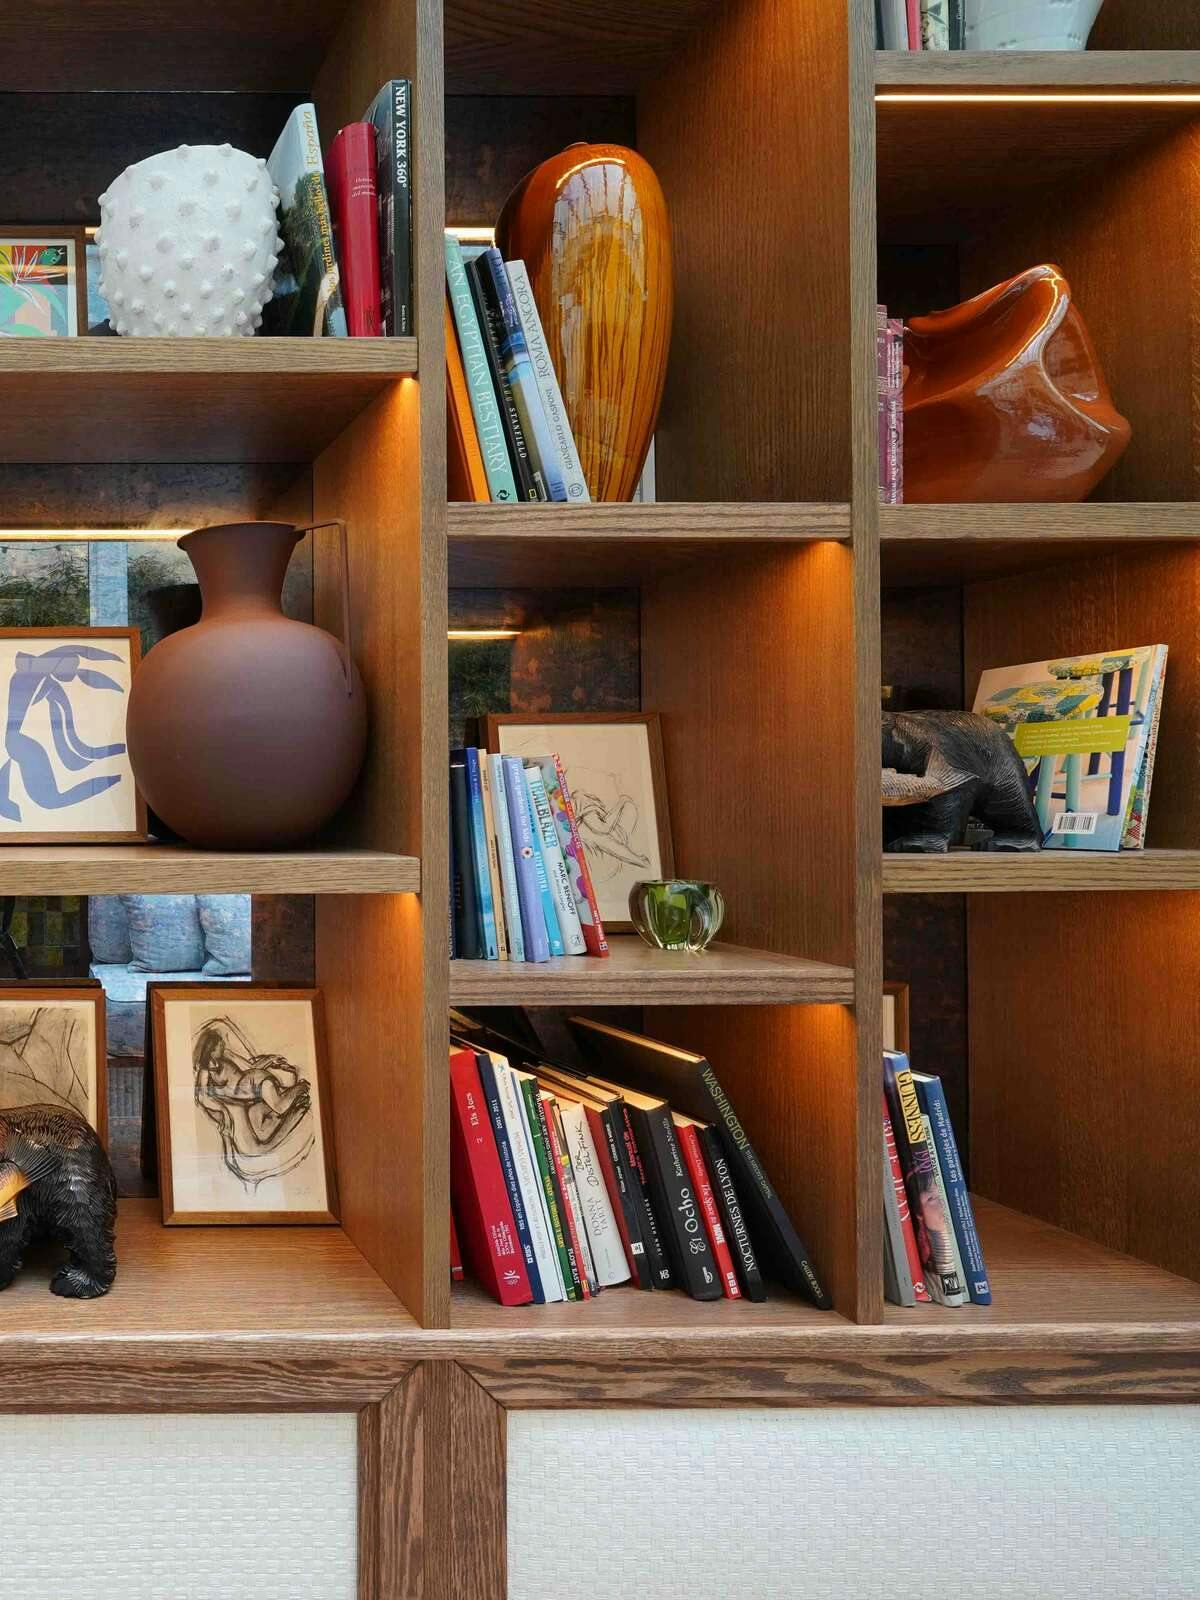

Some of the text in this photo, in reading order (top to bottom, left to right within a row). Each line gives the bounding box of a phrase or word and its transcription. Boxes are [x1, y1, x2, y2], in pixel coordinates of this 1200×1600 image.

[395, 86, 408, 189] NEW YORK 360°
[312, 184, 325, 214] bellos
[511, 274, 551, 379] ROMA ANCORA
[450, 261, 511, 473] AN EGYPTIAN BESTIARY
[509, 407, 526, 458] STANFIELD
[514, 785, 527, 814] gardens
[529, 778, 558, 849] TRAILBLAZER
[557, 772, 570, 803] POLYMER
[569, 817, 583, 849] PROJECTS
[519, 815, 529, 826] for
[522, 826, 532, 844] kids
[557, 861, 576, 916] MARC BENIOFF
[465, 1091, 479, 1126] Els Jocs
[700, 1067, 750, 1151] WASHINGTON
[898, 1072, 924, 1143] GUINNESS
[541, 1124, 549, 1137] ART
[546, 1150, 556, 1175] HISTORY
[573, 1151, 584, 1172] DER
[623, 1130, 637, 1168] Manual de
[662, 1116, 684, 1177] Katherine Neville
[714, 1158, 731, 1189] LYON
[949, 1169, 958, 1183] Los
[676, 1186, 699, 1234] Ocho
[723, 1189, 736, 1205] DE
[893, 1174, 910, 1222] JEAN
[587, 1197, 601, 1237] DONNA
[712, 1223, 725, 1246] MOVE
[524, 1245, 533, 1258] RBS
[654, 1237, 663, 1257] JOHN
[688, 1236, 706, 1256] El
[728, 1206, 756, 1272] NOCTURNES
[567, 1248, 576, 1268] FLOW
[571, 1267, 580, 1285] EAST
[810, 1279, 825, 1300] BOOKS
